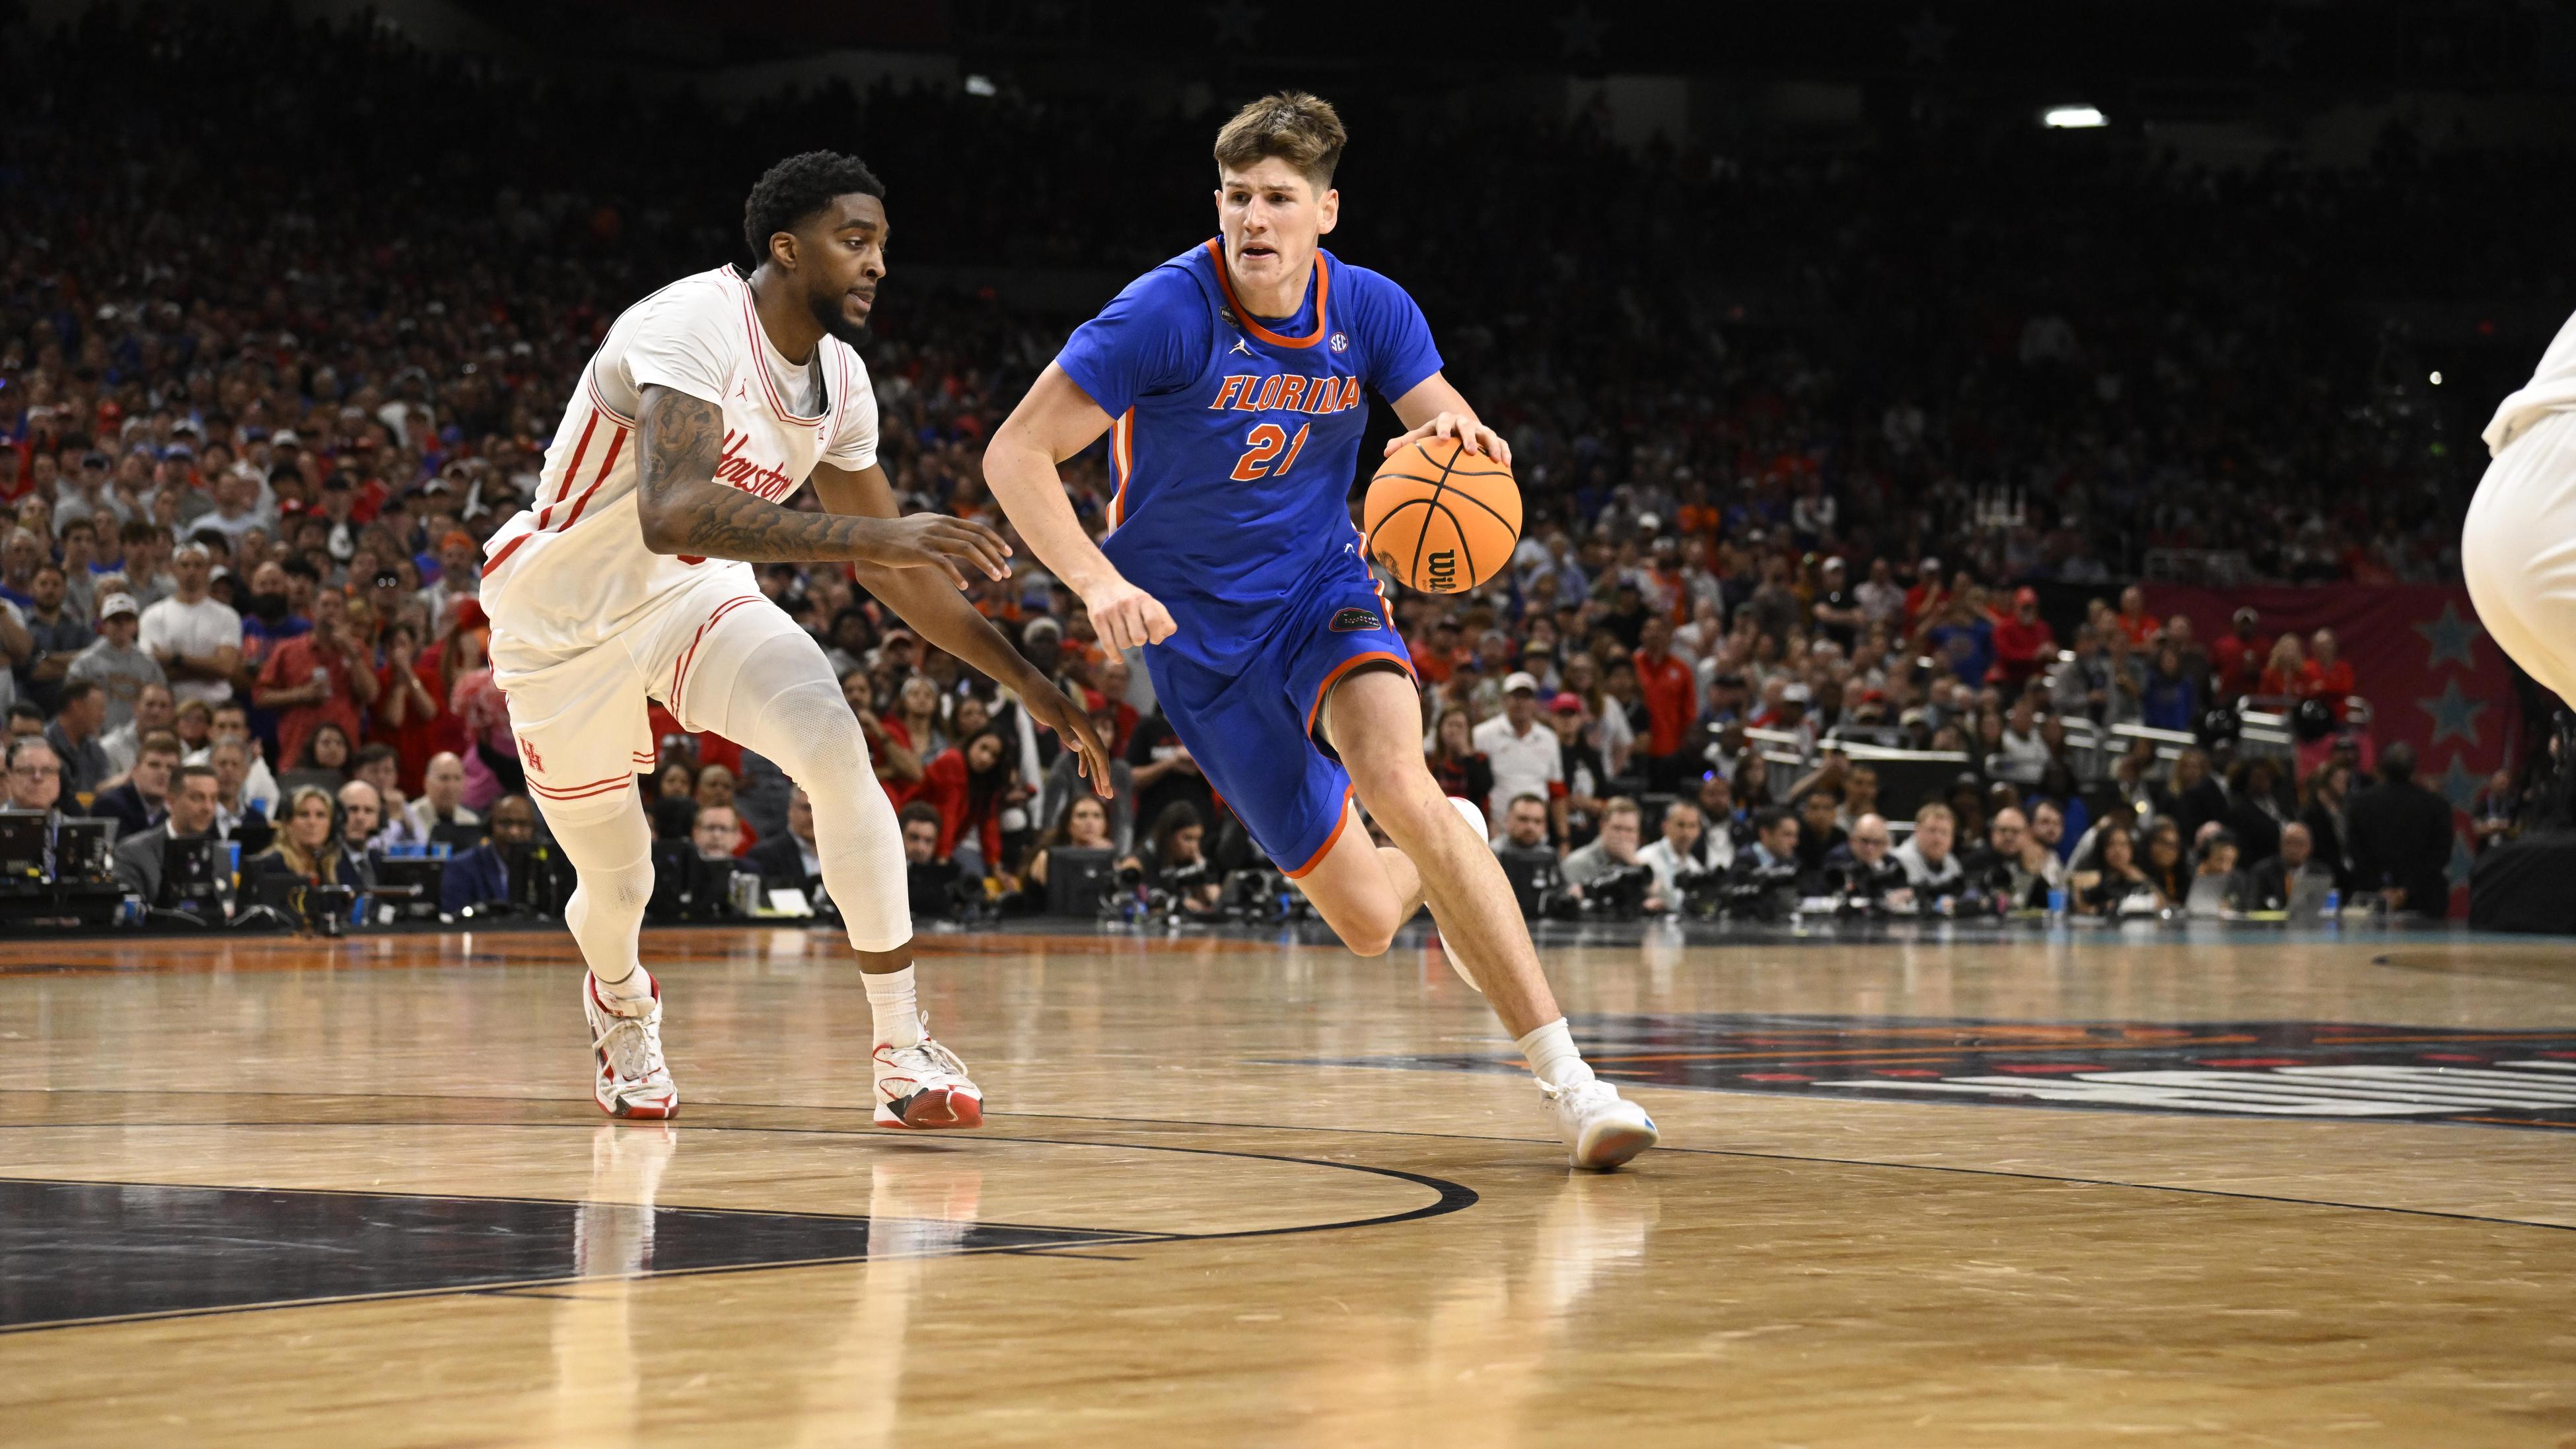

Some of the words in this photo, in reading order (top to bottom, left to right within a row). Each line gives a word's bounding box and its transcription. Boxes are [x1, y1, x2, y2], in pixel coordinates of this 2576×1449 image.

[1331, 334, 1347, 351] SEC
[1207, 374, 1360, 414] FLORIDA
[715, 428, 793, 503] Houston
[1230, 423, 1310, 481] 21
[518, 734, 546, 774] UH
